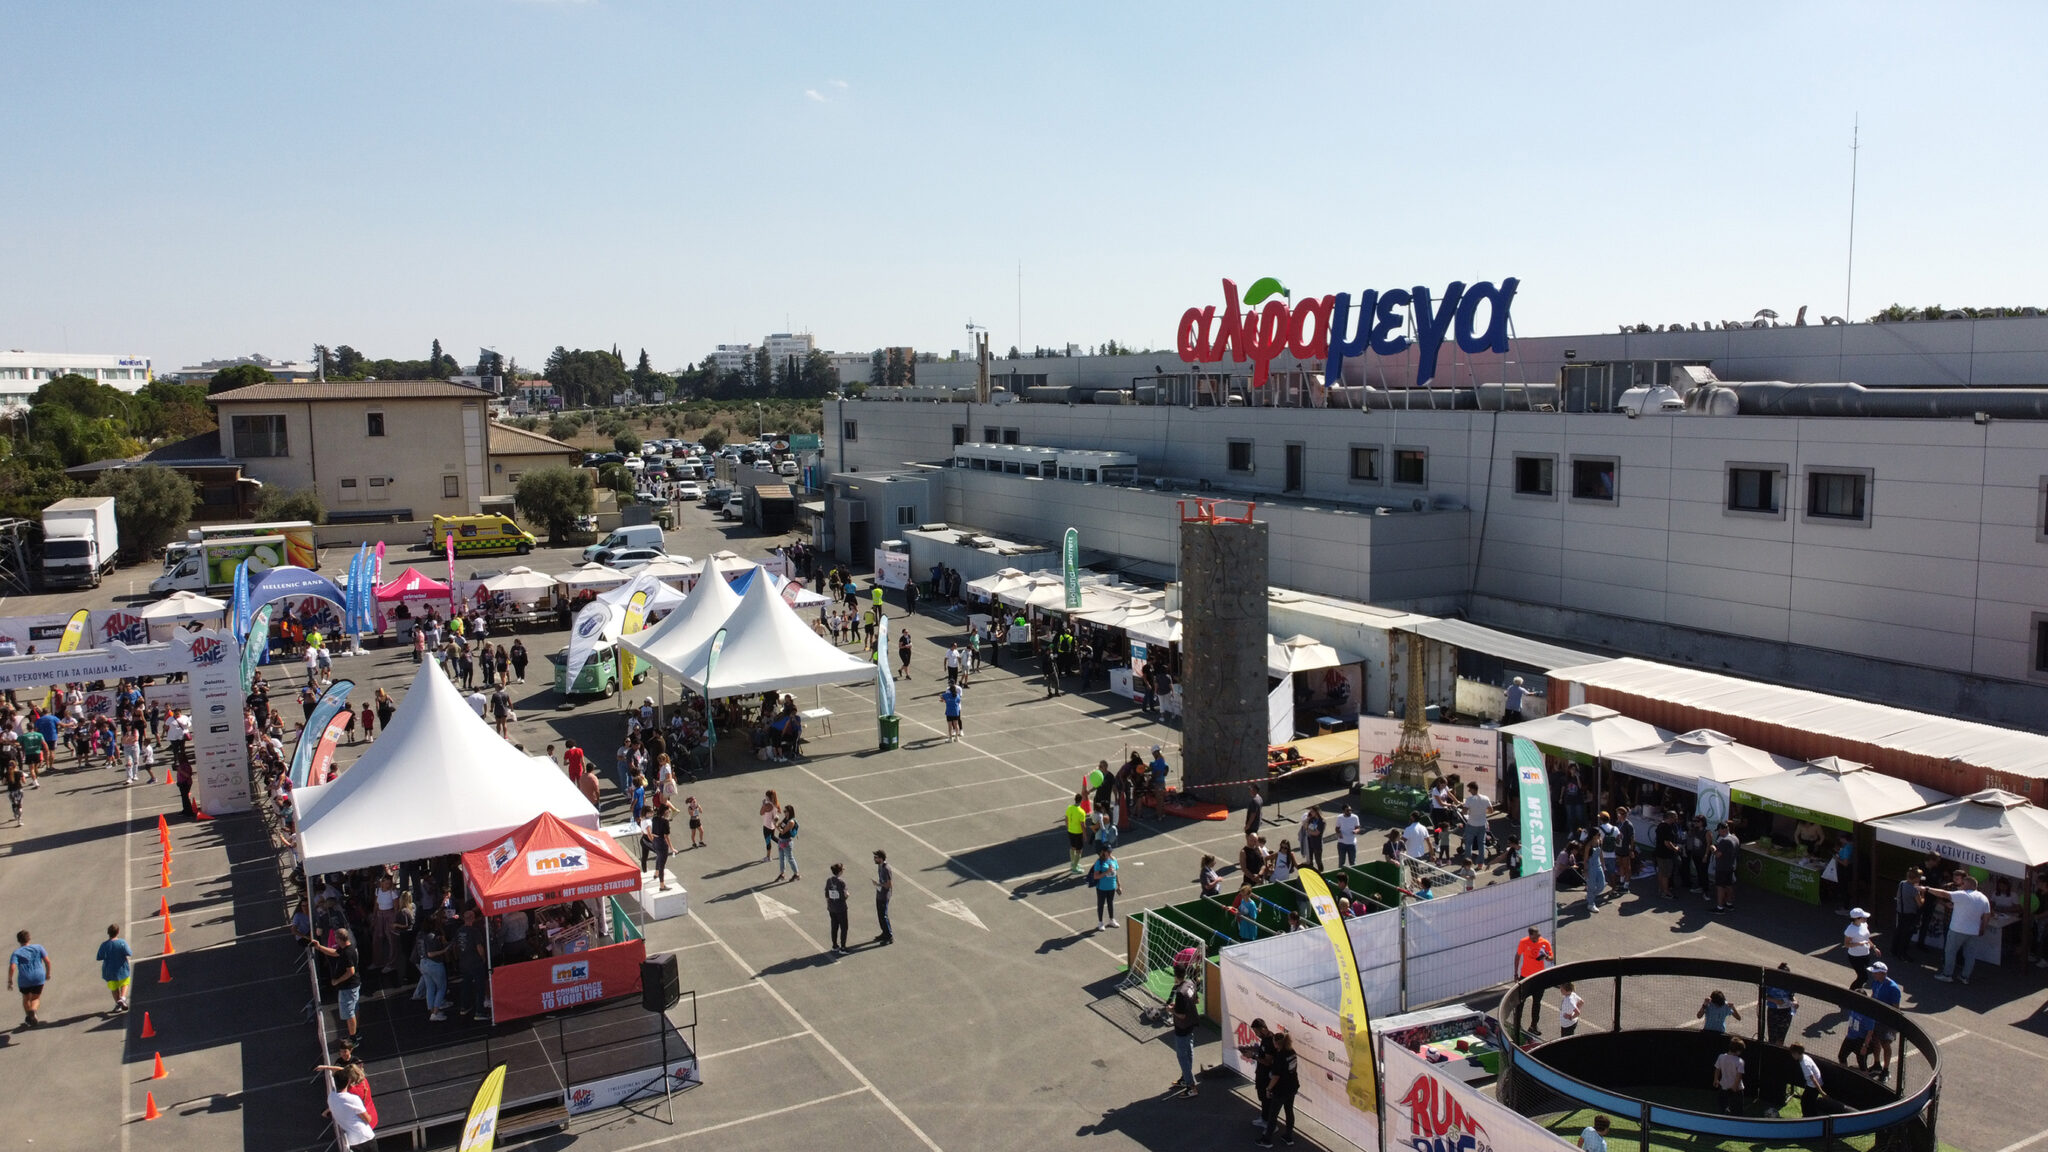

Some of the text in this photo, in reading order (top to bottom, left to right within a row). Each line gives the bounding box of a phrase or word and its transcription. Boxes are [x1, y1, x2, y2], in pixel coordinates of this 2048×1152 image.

[262, 582, 300, 590] HELLENIC
[1069, 571, 1077, 605] Holland
[13, 671, 54, 682] ΤΡΕΧΟΥΜΕ
[57, 669, 70, 678] ΓΙΑ
[72, 668, 81, 676] ΤΑ
[83, 665, 109, 675] ΠΑΙΔΙΑ
[535, 852, 584, 870] mix
[1911, 838, 1987, 865] KIDS ACTIVITIES
[492, 900, 508, 910] THE
[508, 892, 544, 906] ISLAND'S
[563, 888, 576, 897] HIT
[577, 883, 603, 896] MUSIC
[604, 878, 635, 893] STATION
[556, 965, 587, 980] mix
[542, 980, 603, 1000] THE SOUNDTRACK
[542, 988, 603, 1010] TO YOUR LIFE
[1396, 1073, 1482, 1138] RUN
